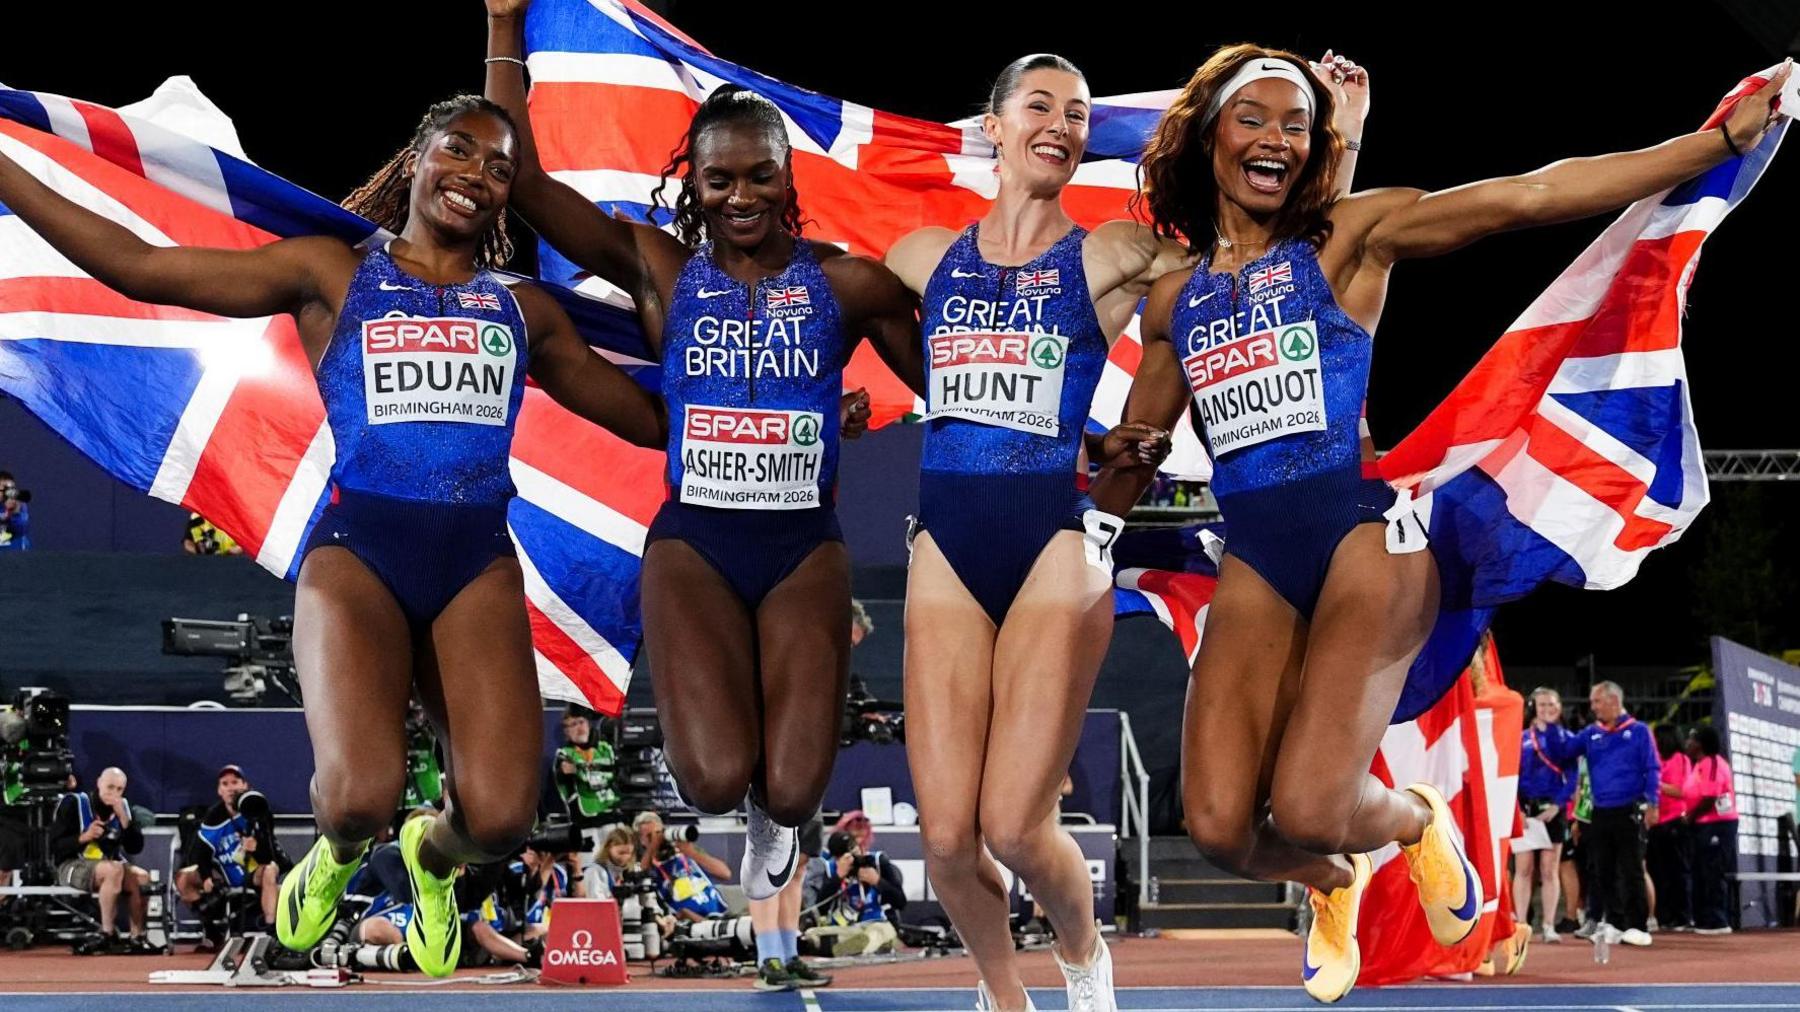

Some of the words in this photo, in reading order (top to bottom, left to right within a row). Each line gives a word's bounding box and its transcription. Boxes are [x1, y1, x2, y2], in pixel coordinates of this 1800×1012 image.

[1016, 288, 1061, 298] Novuna
[1249, 284, 1294, 306] Novuna
[766, 306, 813, 319] Novuna
[942, 295, 1051, 328] GREAT
[1187, 295, 1286, 355] GREAT
[369, 325, 476, 349] SPAR
[693, 315, 806, 348] GREAT
[685, 346, 818, 379] BRITAIN
[933, 338, 1026, 364] SPAR
[1188, 338, 1275, 387] SPAR
[374, 360, 505, 395] EDUAN
[943, 372, 1043, 405] HUNT
[374, 402, 473, 417] BIRMINGHAM
[476, 405, 503, 419] 2026
[1201, 368, 1317, 426] ANSIQUOT
[689, 413, 787, 440] SPAR
[1018, 412, 1053, 429] 2026
[1212, 417, 1283, 449] RMINGHAM
[1287, 411, 1321, 427] 2026
[686, 448, 817, 483] ASHER-SMITH
[686, 485, 780, 503] BIRMINGHAM
[784, 490, 814, 503] 2026
[548, 949, 618, 966] OMEGA
